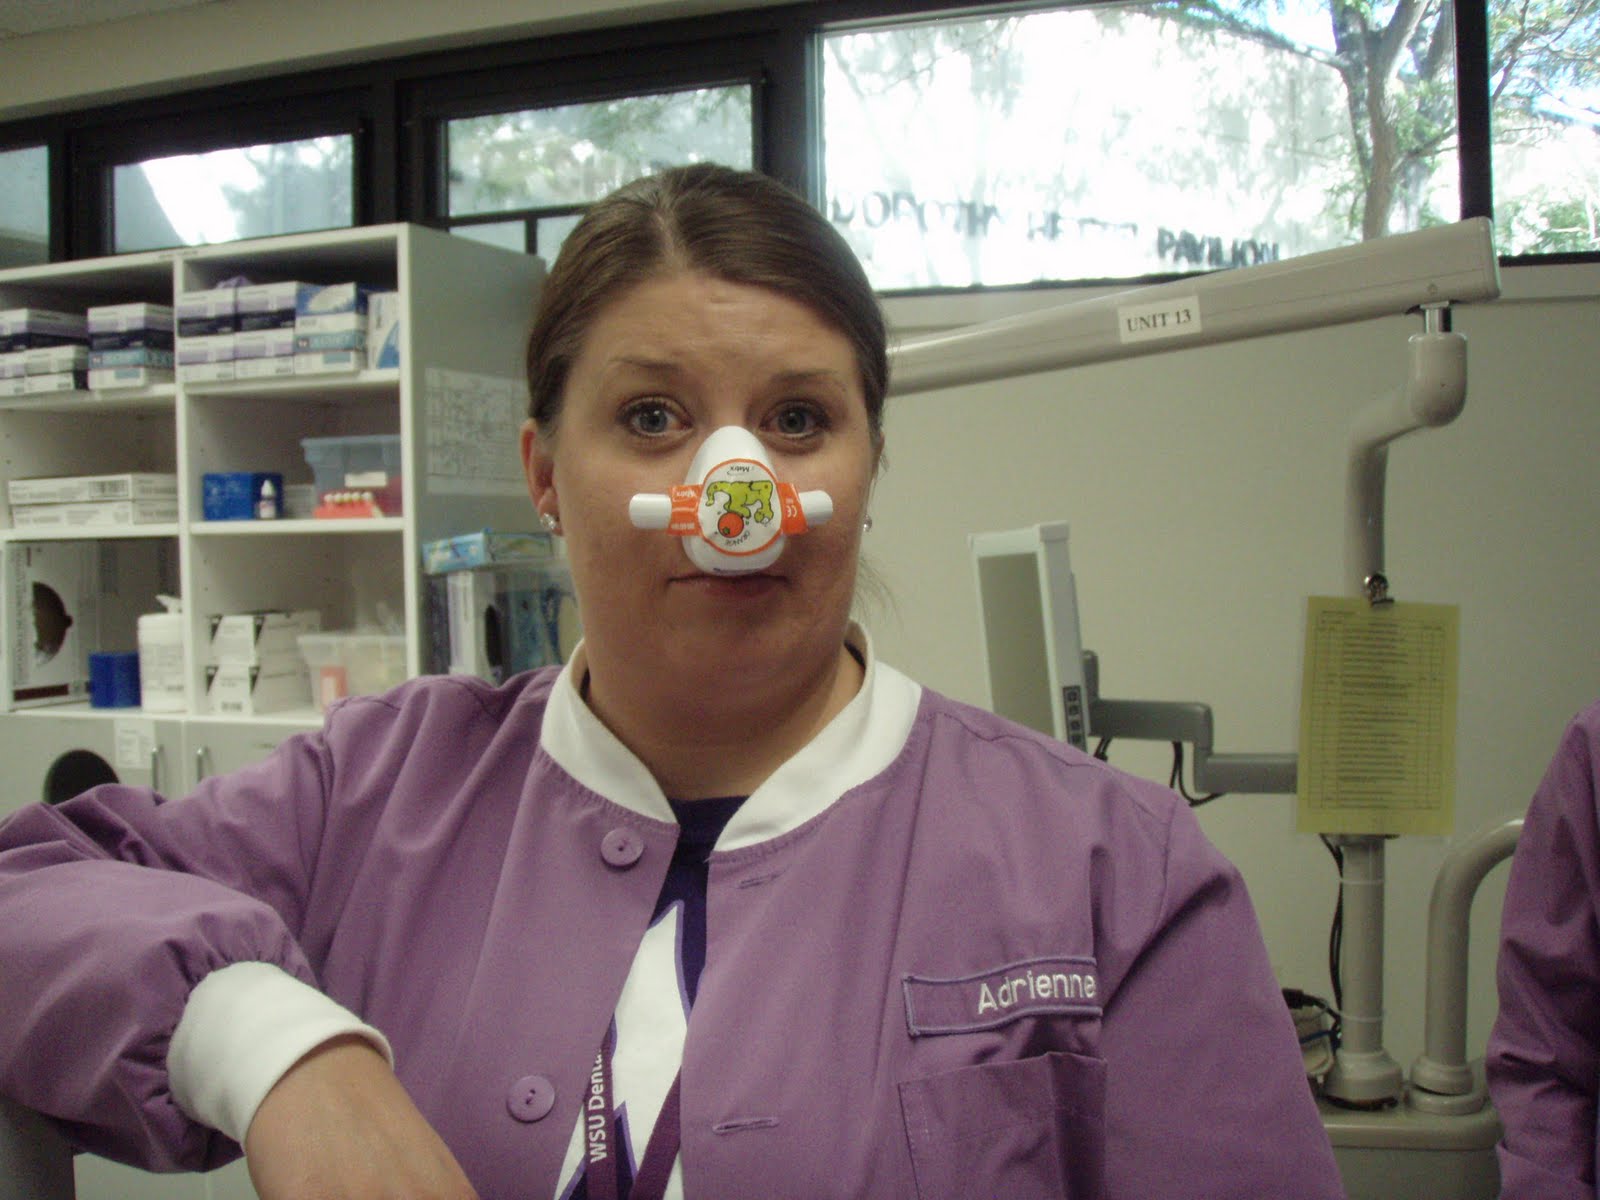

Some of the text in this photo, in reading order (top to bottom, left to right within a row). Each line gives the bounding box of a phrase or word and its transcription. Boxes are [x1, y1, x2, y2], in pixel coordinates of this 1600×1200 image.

[1126, 308, 1192, 333] UNIT 13
[977, 970, 1097, 1015] Adrienne
[587, 1114, 608, 1164] WSU
